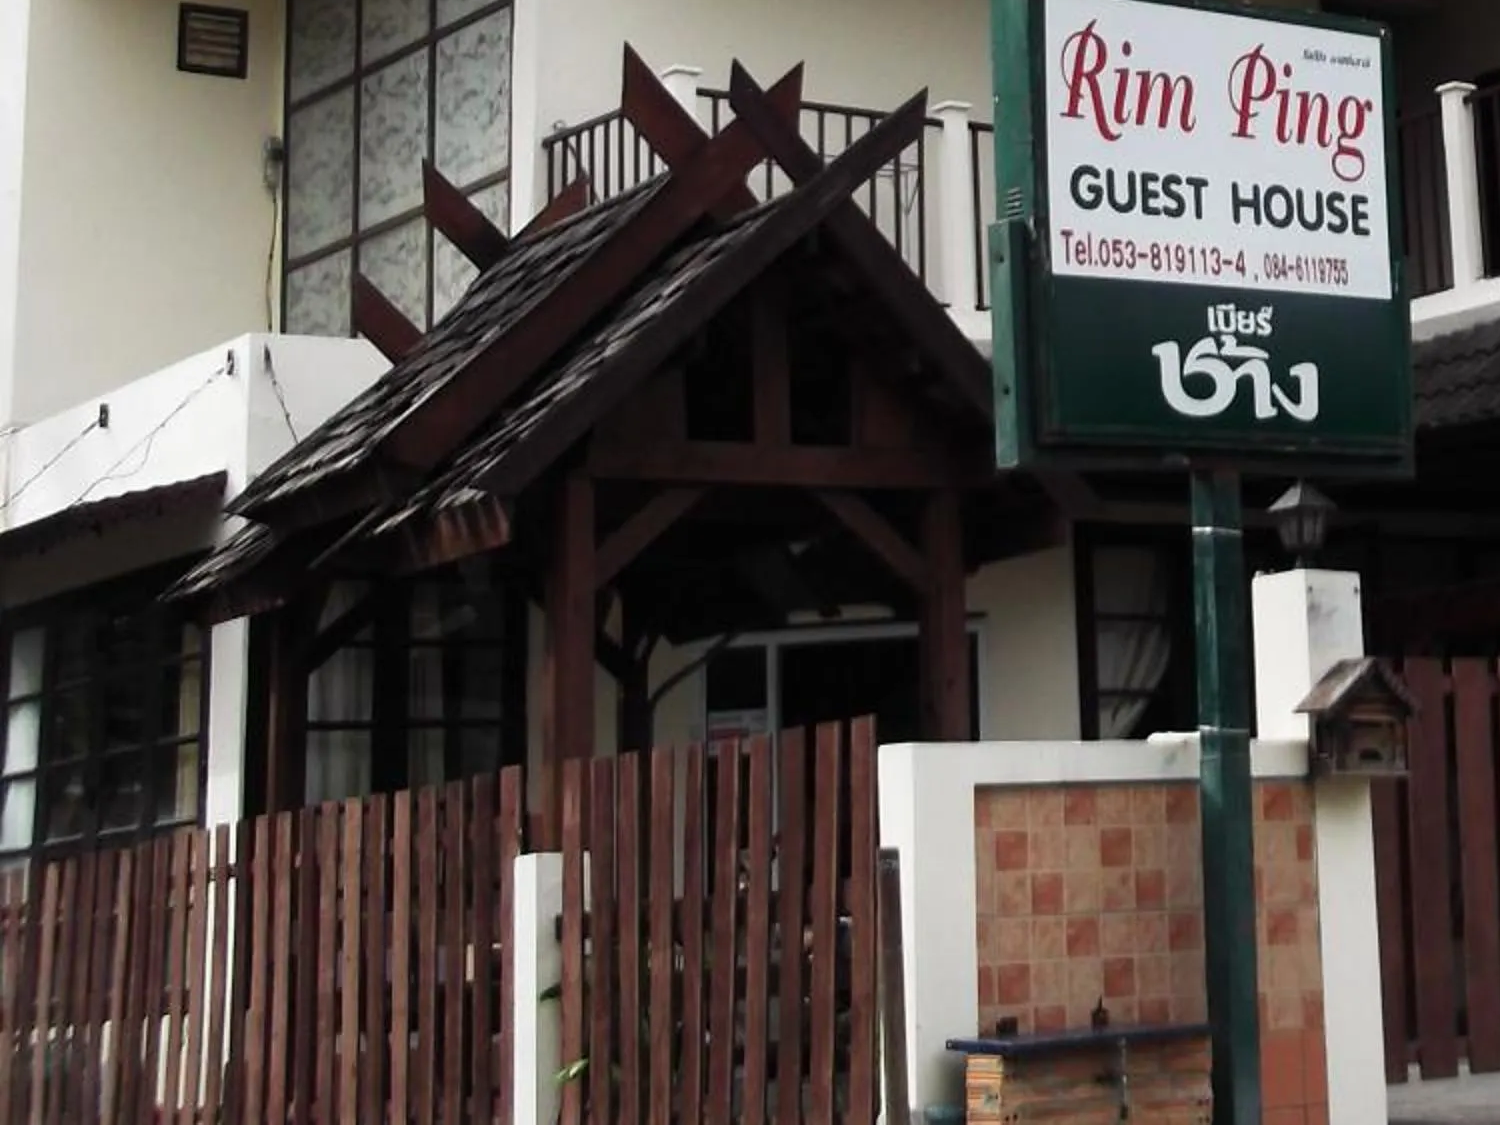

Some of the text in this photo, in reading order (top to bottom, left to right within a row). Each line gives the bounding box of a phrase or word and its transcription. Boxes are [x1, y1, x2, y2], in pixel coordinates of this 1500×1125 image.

[1059, 19, 1373, 182] Rim Ping
[1069, 164, 1371, 236] GUEST HOUSE
[1207, 303, 1273, 336] เบียร์
[1151, 334, 1319, 421] ช้าง
